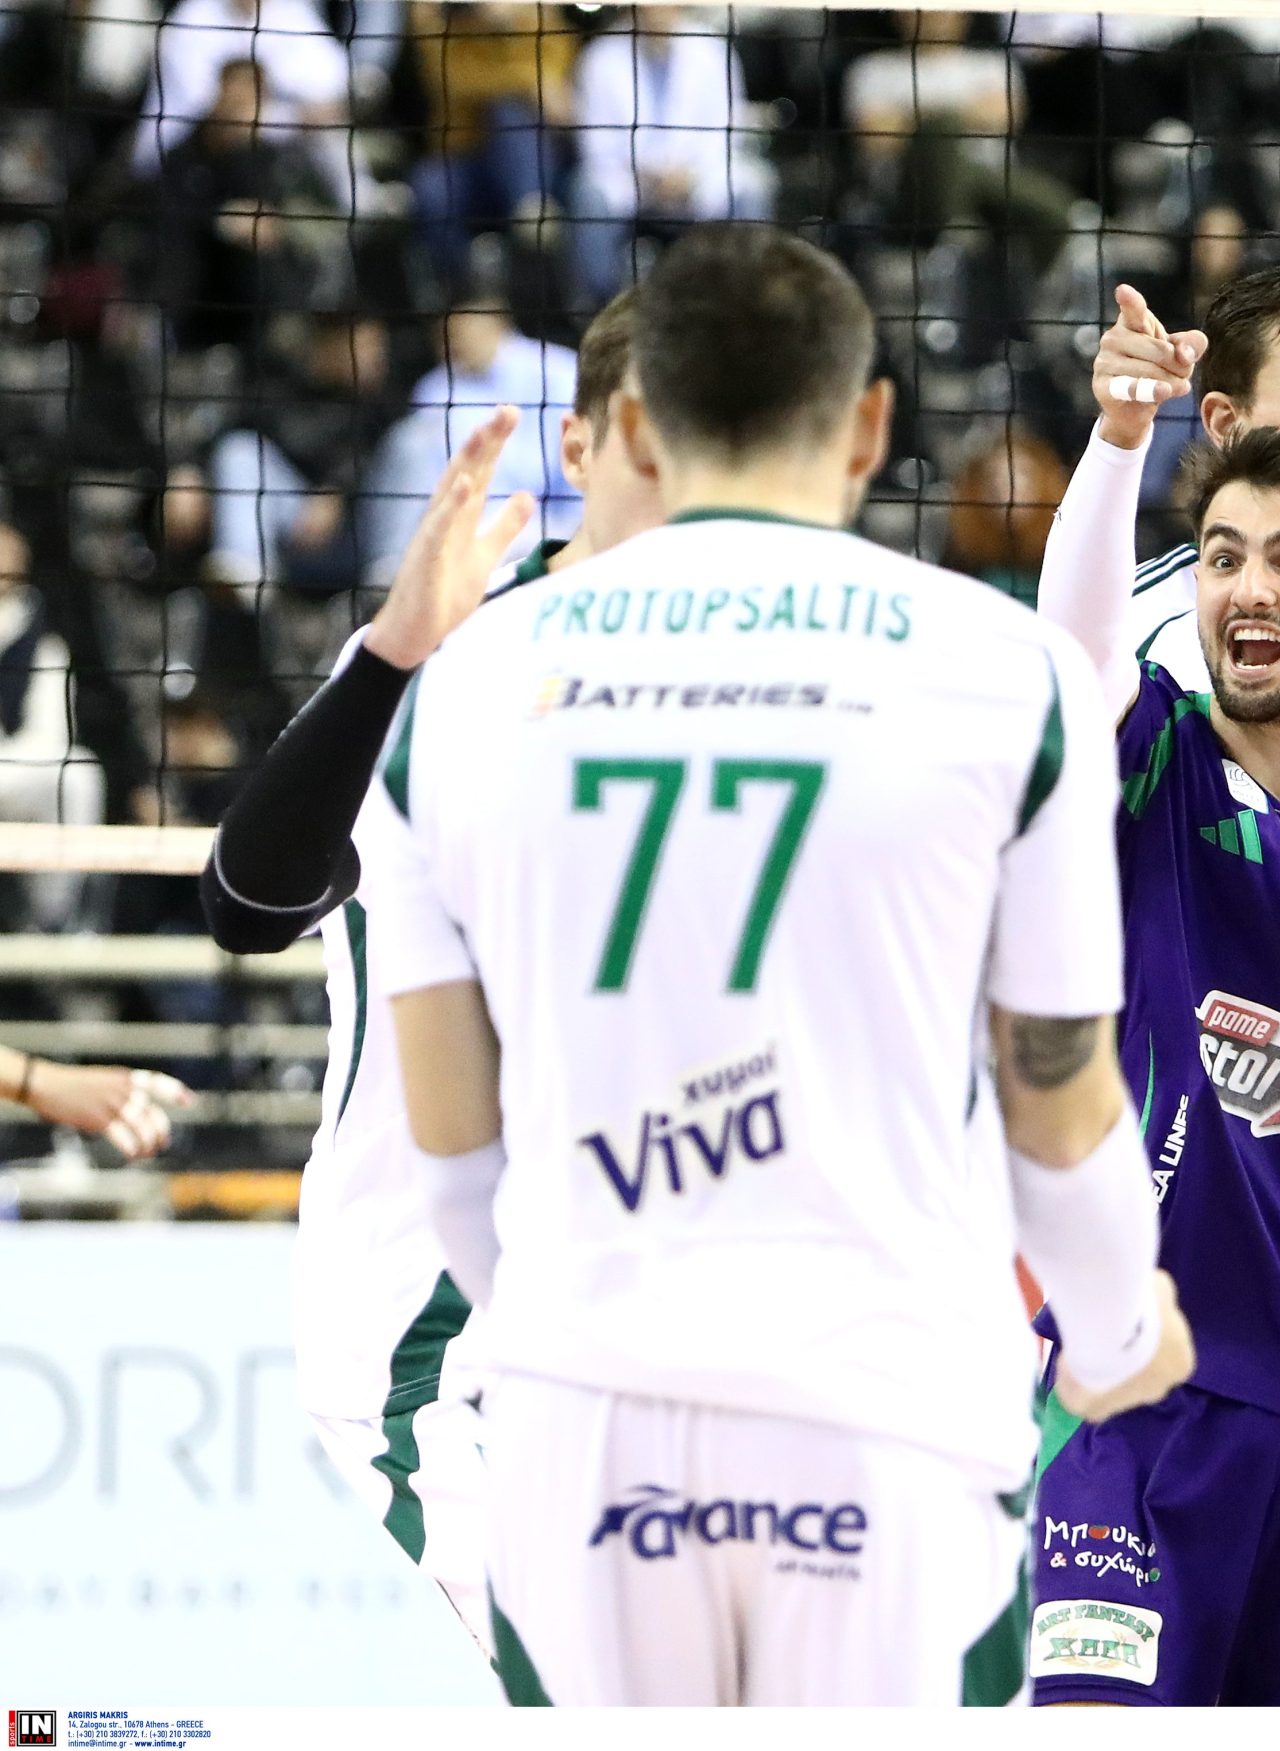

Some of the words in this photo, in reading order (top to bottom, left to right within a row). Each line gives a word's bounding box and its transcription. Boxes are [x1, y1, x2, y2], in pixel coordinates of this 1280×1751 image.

[531, 582, 913, 642] PROTOPSALTIS
[571, 758, 828, 994] 77
[1208, 1005, 1271, 1039] pame
[577, 1090, 785, 1213] Viva
[1050, 1552, 1067, 1568] &
[1036, 1607, 1071, 1637] ART
[1074, 1604, 1155, 1643] FANTASY
